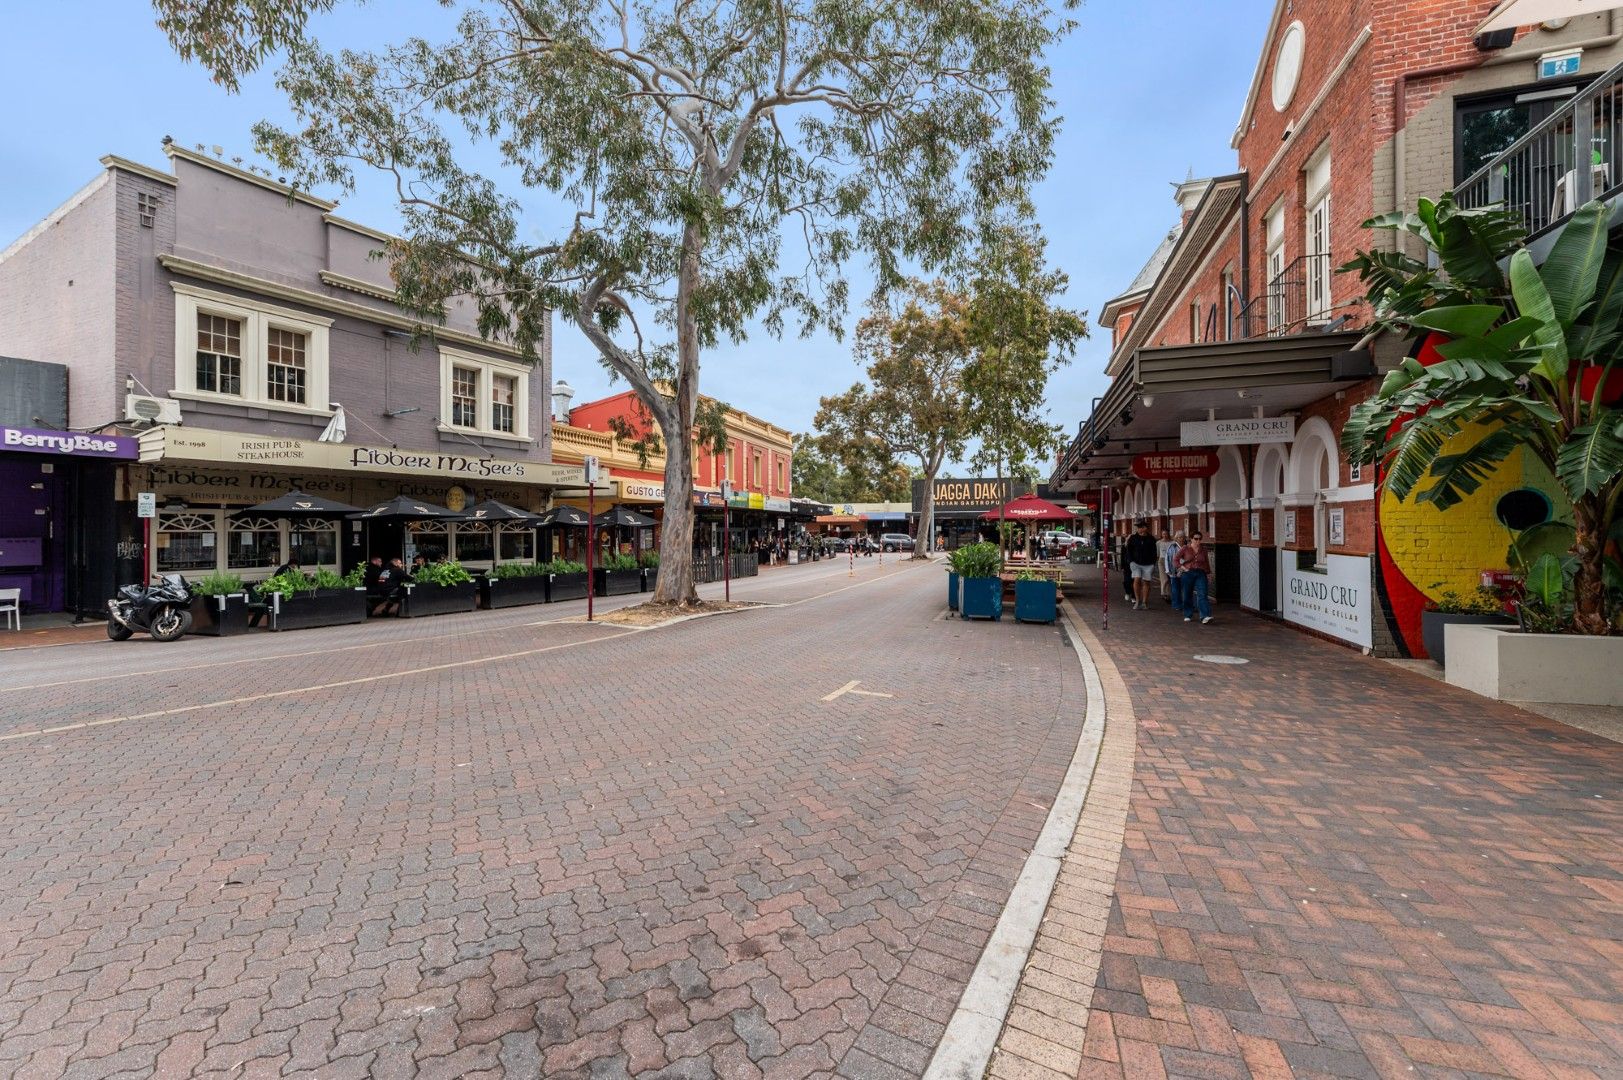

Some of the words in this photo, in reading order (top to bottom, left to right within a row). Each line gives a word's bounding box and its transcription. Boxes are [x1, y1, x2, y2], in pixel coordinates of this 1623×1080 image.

[1216, 422, 1259, 432] GRAND
[1263, 421, 1288, 430] CRU
[4, 429, 117, 452] BerryBae
[241, 442, 270, 450] IRISH
[273, 441, 292, 449] PUB
[294, 441, 301, 449] &
[237, 451, 305, 460] STEAKHOUSE
[350, 447, 432, 468] Fibber
[438, 456, 525, 477] McGee's
[1143, 456, 1162, 469] THE
[1163, 456, 1180, 468] RED
[1181, 455, 1208, 468] ROOM
[626, 485, 654, 497] GUSTO
[933, 482, 971, 500] JAGGA
[1290, 577, 1328, 600] GRAND
[1331, 585, 1357, 608] CRU
[1332, 609, 1358, 622] CELLAR
